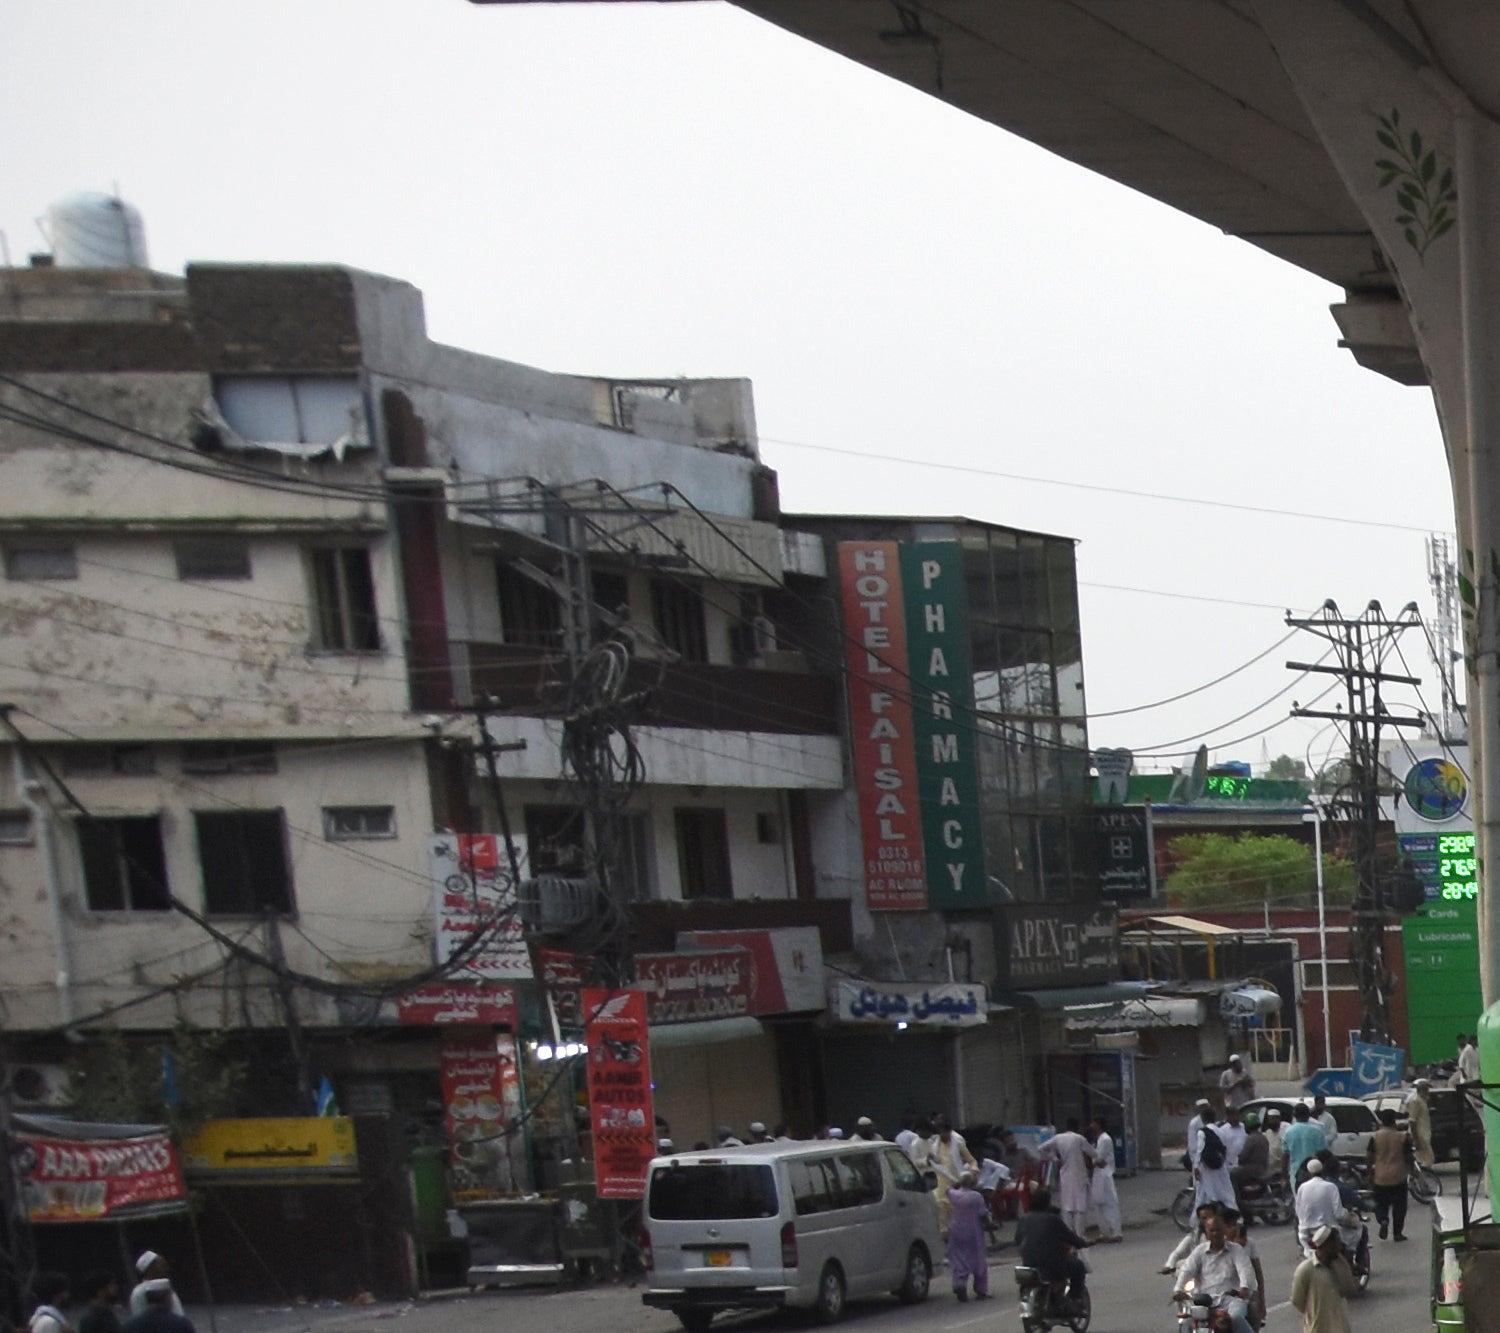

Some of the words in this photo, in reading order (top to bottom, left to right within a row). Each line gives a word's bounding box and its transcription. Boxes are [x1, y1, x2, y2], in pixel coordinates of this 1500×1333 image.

[854, 550, 892, 673] HOTEL
[922, 559, 965, 891] PHARMACY
[870, 692, 906, 840] FAISAL
[869, 879, 884, 890] AC
[1429, 909, 1458, 919] Cards
[1011, 919, 1061, 958] APEX
[1418, 931, 1472, 942] Lubricants
